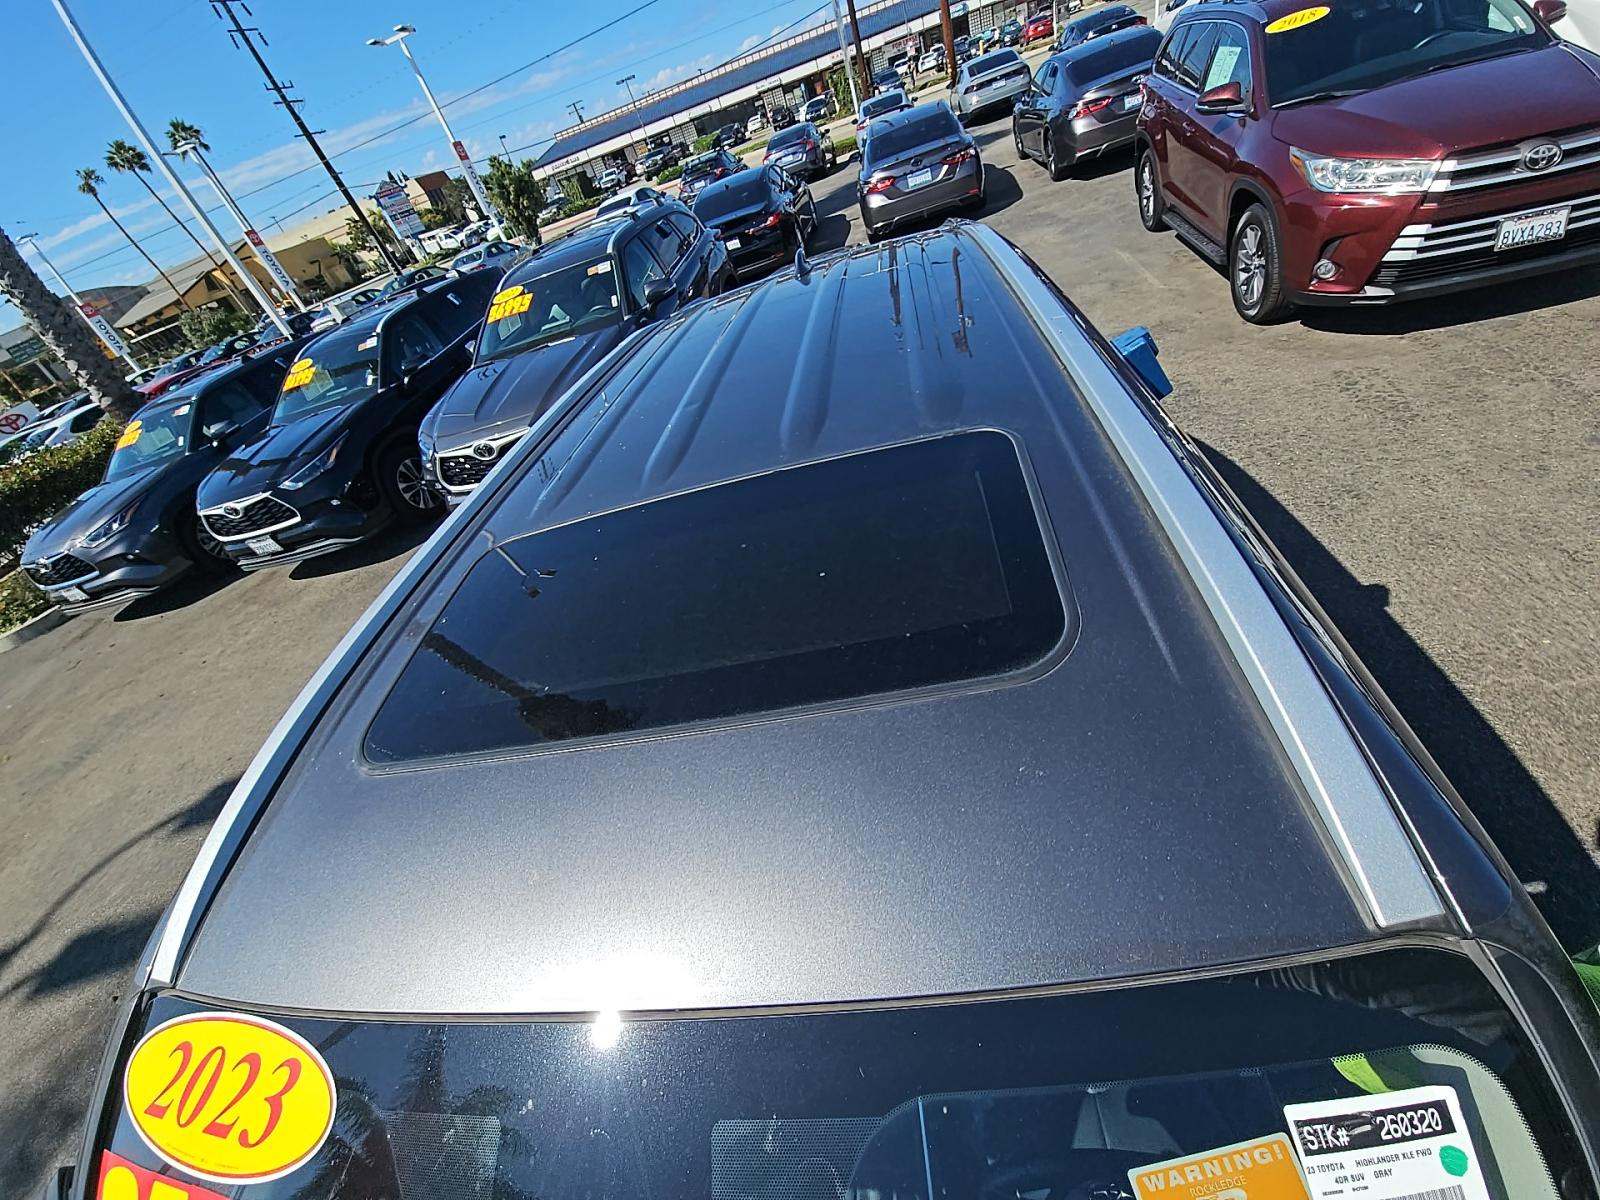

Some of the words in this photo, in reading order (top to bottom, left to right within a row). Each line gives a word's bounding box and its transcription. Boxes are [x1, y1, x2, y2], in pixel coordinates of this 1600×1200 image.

[1502, 220, 1562, 245] 8VXA283
[262, 248, 290, 287] TOYOTA
[95, 319, 124, 352] TOYOTA
[144, 1041, 301, 1148] 2023
[1303, 1123, 1350, 1151] STK#
[1375, 1107, 1442, 1141] 260320
[1143, 1143, 1284, 1192] WARNING!
[1317, 1163, 1345, 1173] TOYOTA
[1355, 1151, 1401, 1168] HIGHLANDER
[1402, 1150, 1416, 1160] XLE
[1416, 1147, 1433, 1158] FWD
[1335, 1175, 1350, 1184] 4DR
[1351, 1173, 1365, 1182] SUV
[1373, 1168, 1394, 1179] GRAY
[1189, 1175, 1248, 1197] ROCKLEDGE
